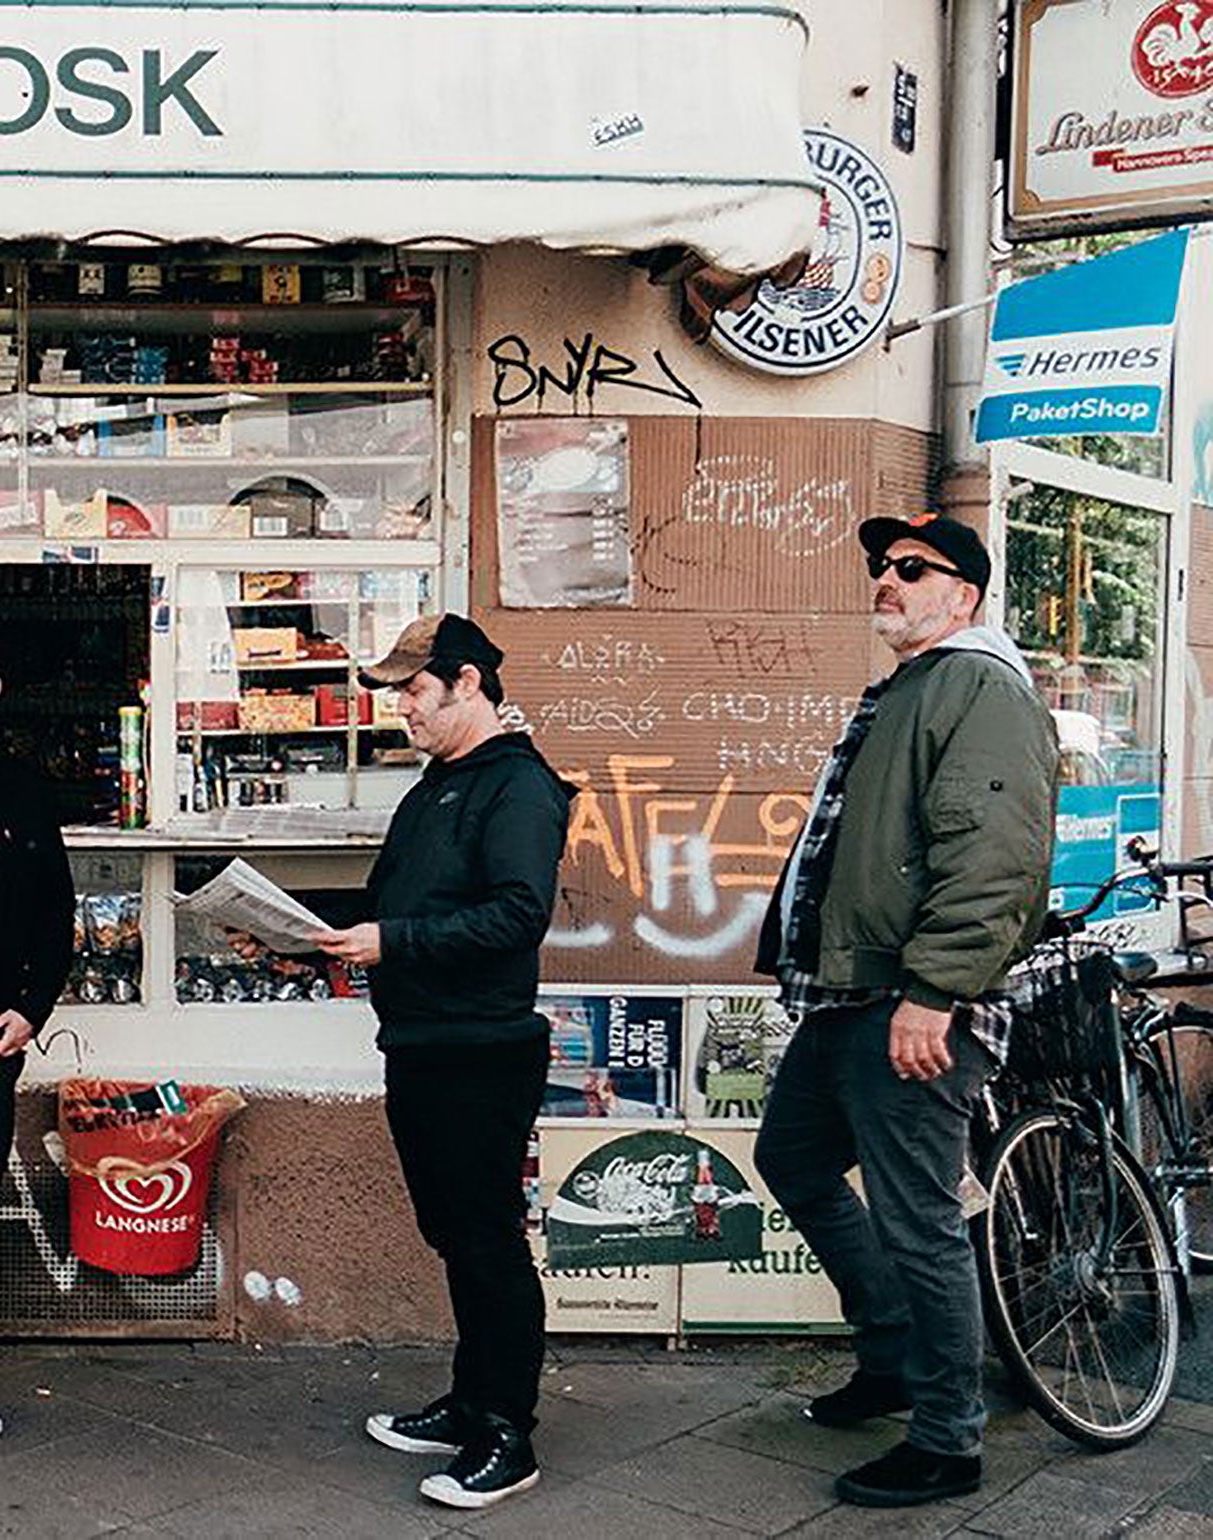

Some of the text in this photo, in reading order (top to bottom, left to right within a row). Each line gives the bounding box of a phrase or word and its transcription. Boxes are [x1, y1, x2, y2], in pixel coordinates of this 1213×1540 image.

[1036, 110, 1193, 156] Lindener
[733, 305, 869, 357] ILSENER
[1027, 345, 1162, 376] Hermes
[1010, 398, 1150, 423] PaketShop
[95, 1210, 189, 1233] LANGNESE
